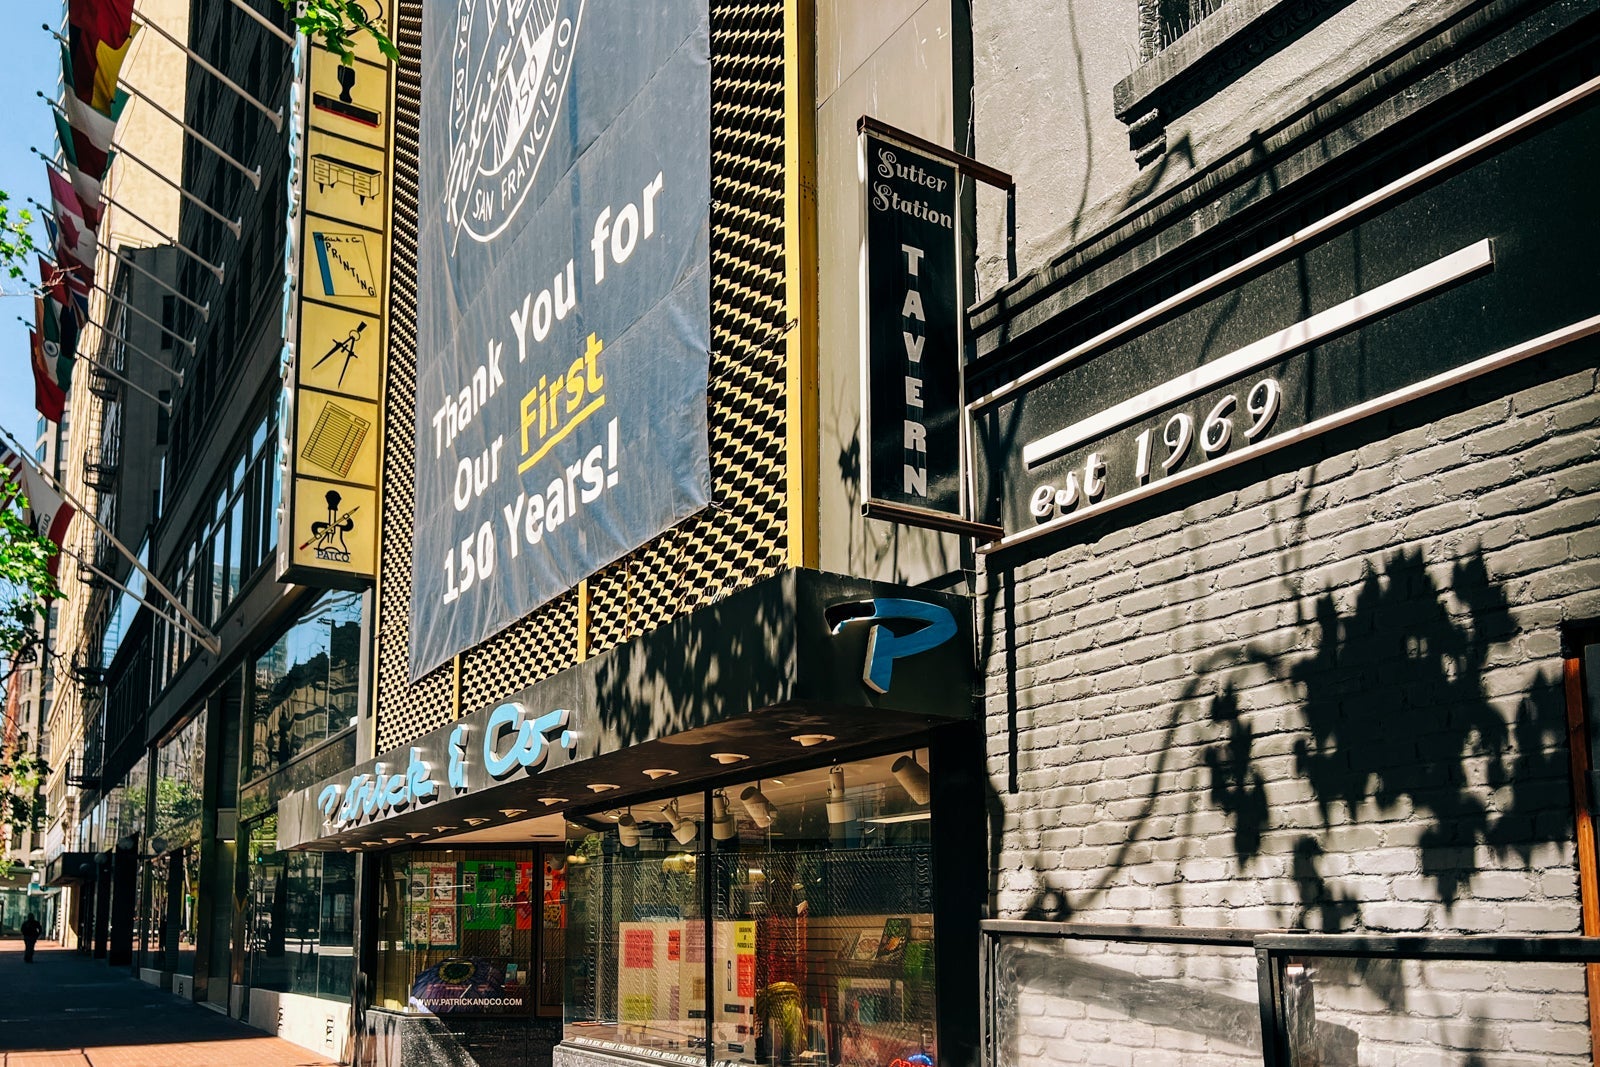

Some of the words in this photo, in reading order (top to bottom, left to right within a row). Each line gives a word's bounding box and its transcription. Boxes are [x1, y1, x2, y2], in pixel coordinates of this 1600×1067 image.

[472, 187, 494, 221] SAN
[501, 17, 572, 211] FRANCISCO
[877, 148, 948, 192] Sutter
[873, 181, 952, 229] Station
[325, 242, 375, 297] PRINTING
[432, 338, 504, 460] Thank
[509, 258, 576, 363] You
[590, 170, 663, 285] for
[454, 434, 503, 511] Our
[520, 332, 604, 456] First
[901, 243, 928, 497] TAVERN
[1030, 452, 1106, 518] est
[1135, 378, 1280, 480] 1969
[317, 550, 350, 562] PATCO
[443, 521, 494, 605] 150
[503, 416, 619, 559] Years!
[824, 598, 958, 694] P
[483, 702, 578, 778] Co.
